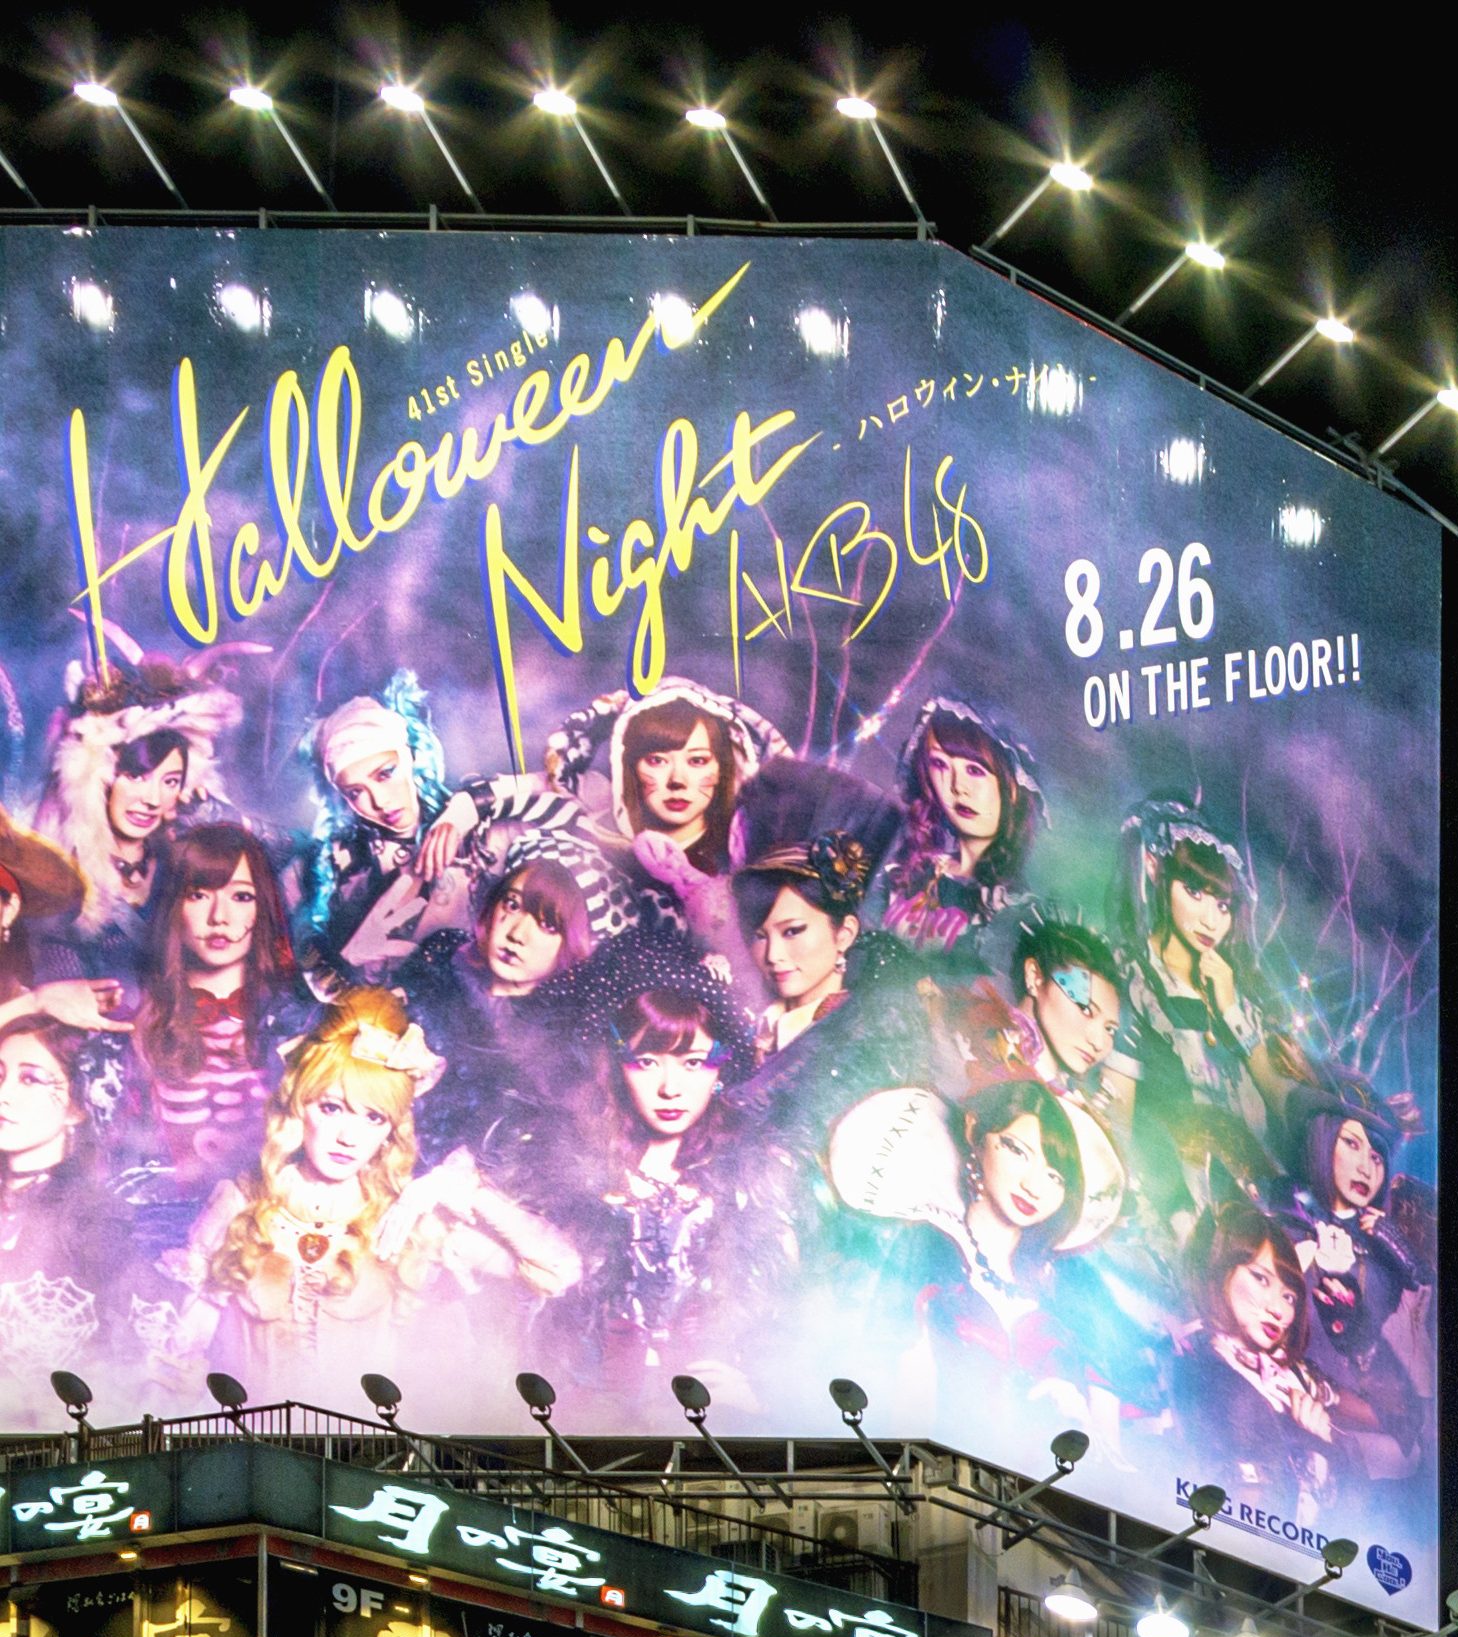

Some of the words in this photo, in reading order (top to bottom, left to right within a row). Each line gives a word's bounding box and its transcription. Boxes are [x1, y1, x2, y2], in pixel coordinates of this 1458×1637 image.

[408, 375, 460, 420] 41st
[467, 331, 549, 387] Single
[70, 261, 750, 686] Halloween
[484, 411, 824, 776] Night
[729, 444, 989, 697] AKB48
[1064, 541, 1215, 658] 8.26
[1083, 664, 1132, 727] ON
[1142, 655, 1209, 717] THE
[1225, 630, 1362, 705] FLOOR!!
[328, 1485, 606, 1598] 月の宴
[332, 1584, 385, 1618] 9F
